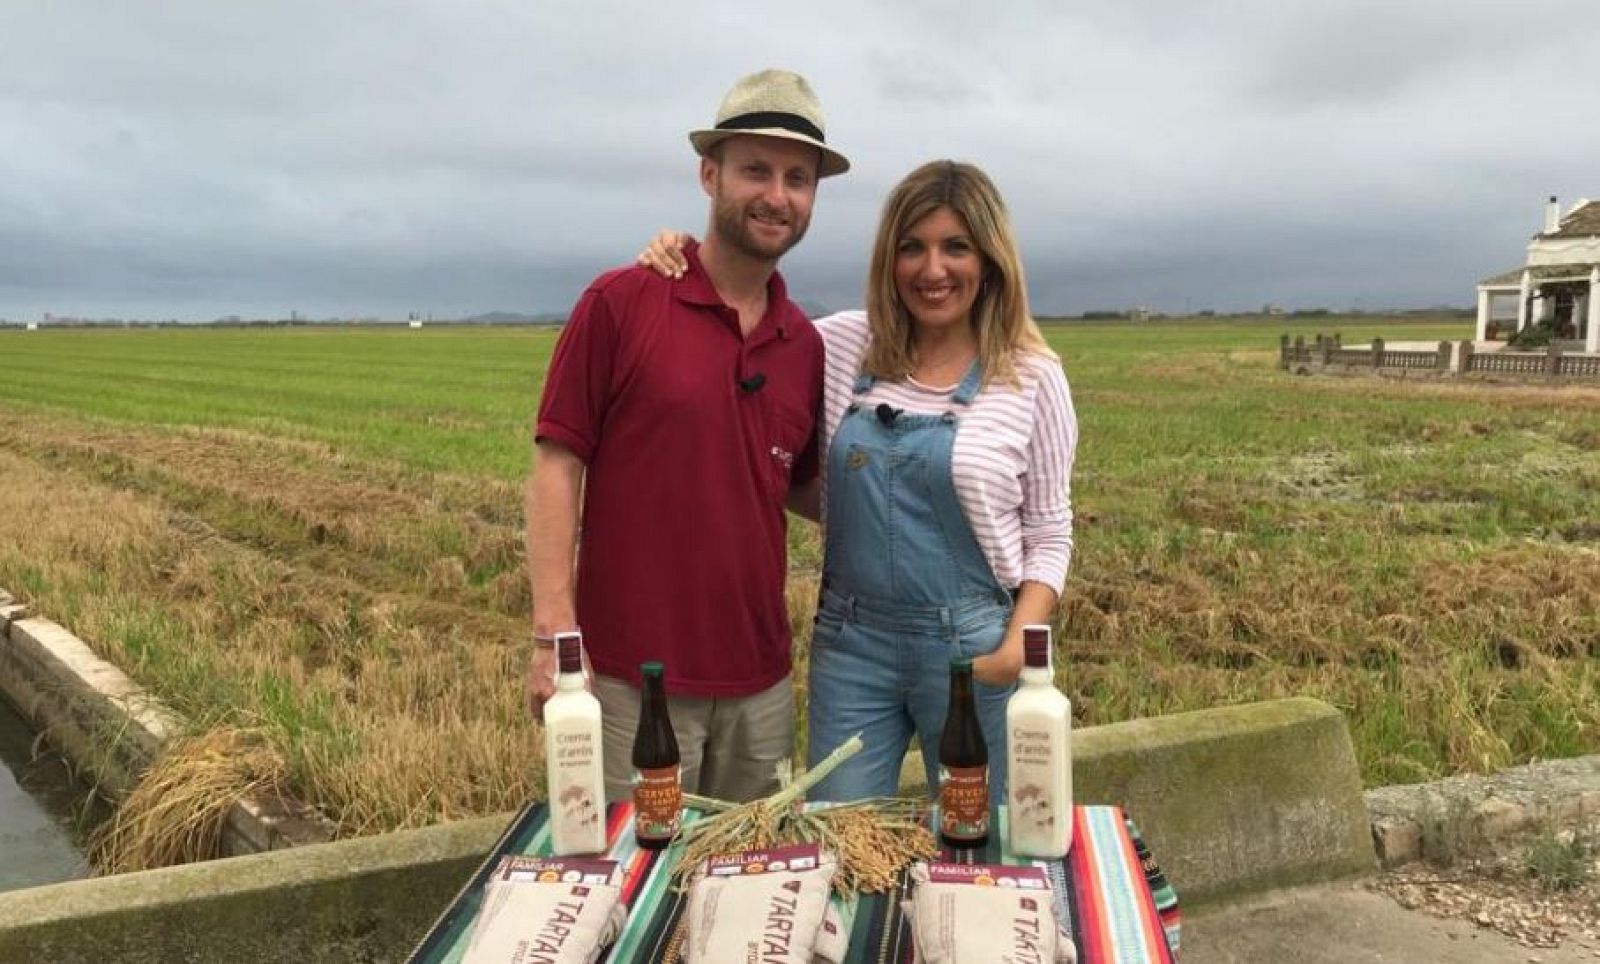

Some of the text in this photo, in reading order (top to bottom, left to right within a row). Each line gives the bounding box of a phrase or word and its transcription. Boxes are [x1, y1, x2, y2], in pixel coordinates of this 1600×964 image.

[511, 859, 564, 871] FAMILIAR
[709, 854, 769, 866] FAMILIAR
[930, 865, 991, 876] FAMILIAR
